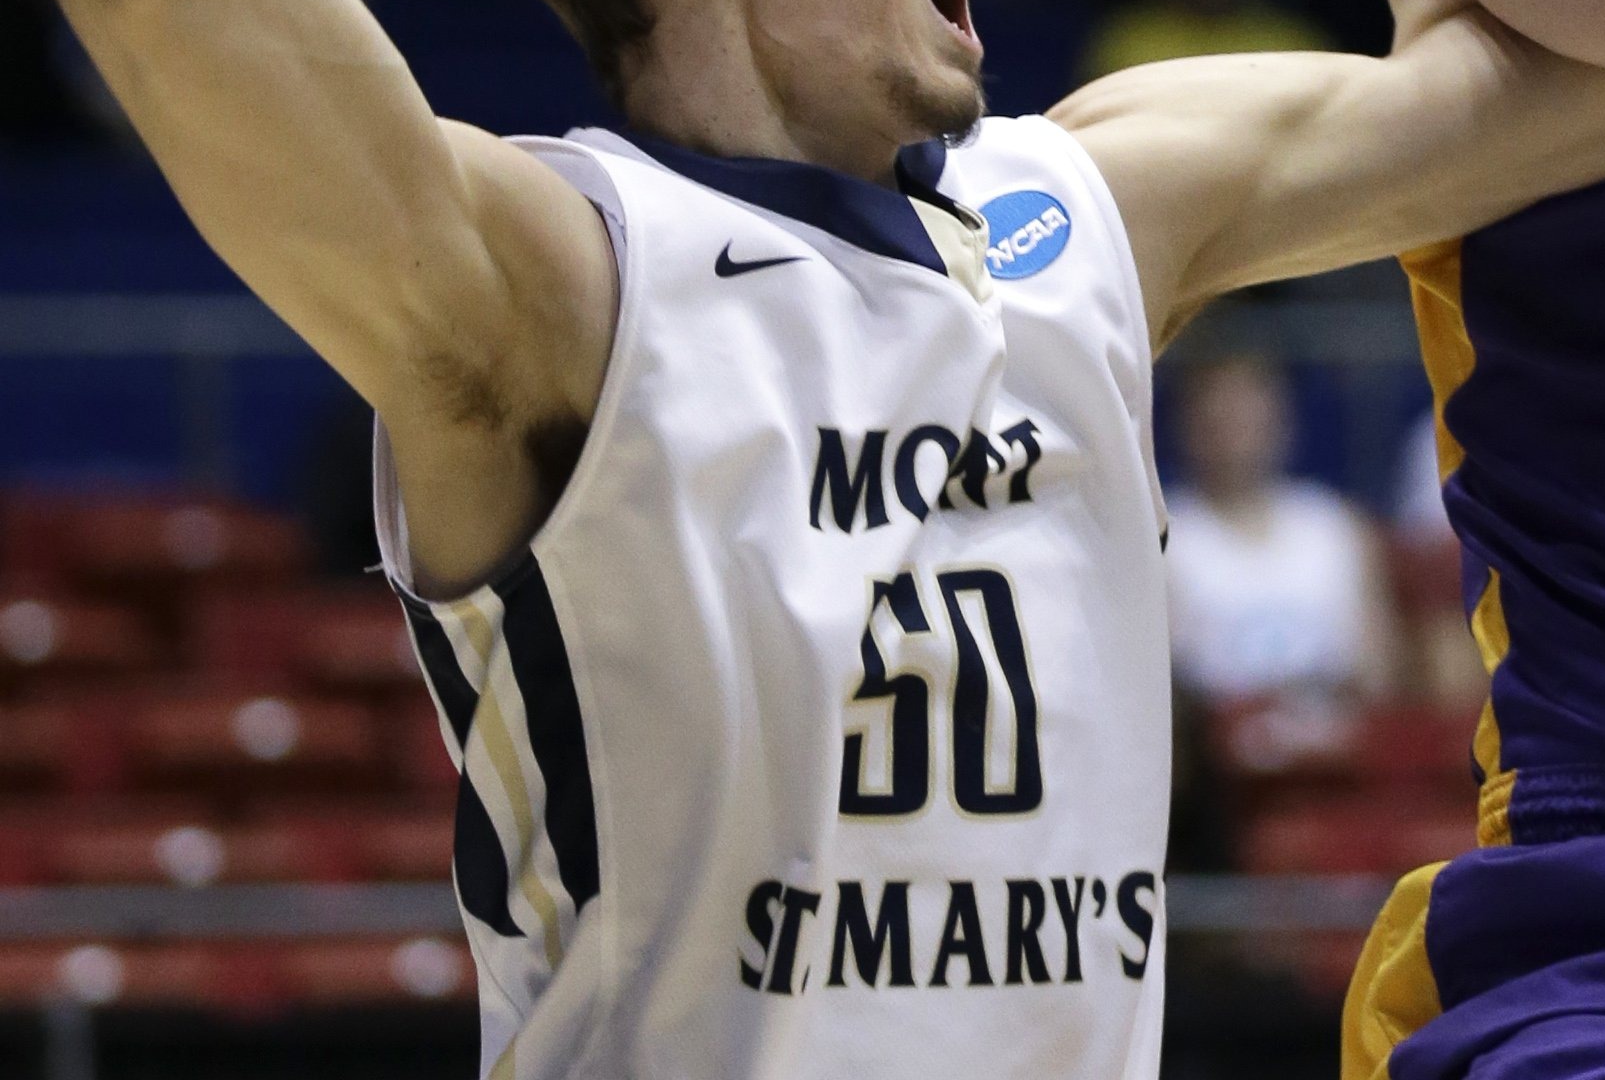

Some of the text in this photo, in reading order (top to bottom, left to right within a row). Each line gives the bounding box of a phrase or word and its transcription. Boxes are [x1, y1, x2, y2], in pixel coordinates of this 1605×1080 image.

[985, 204, 1069, 270] NCAA
[837, 561, 1045, 819] 50
[825, 871, 1158, 988] MARY'S
